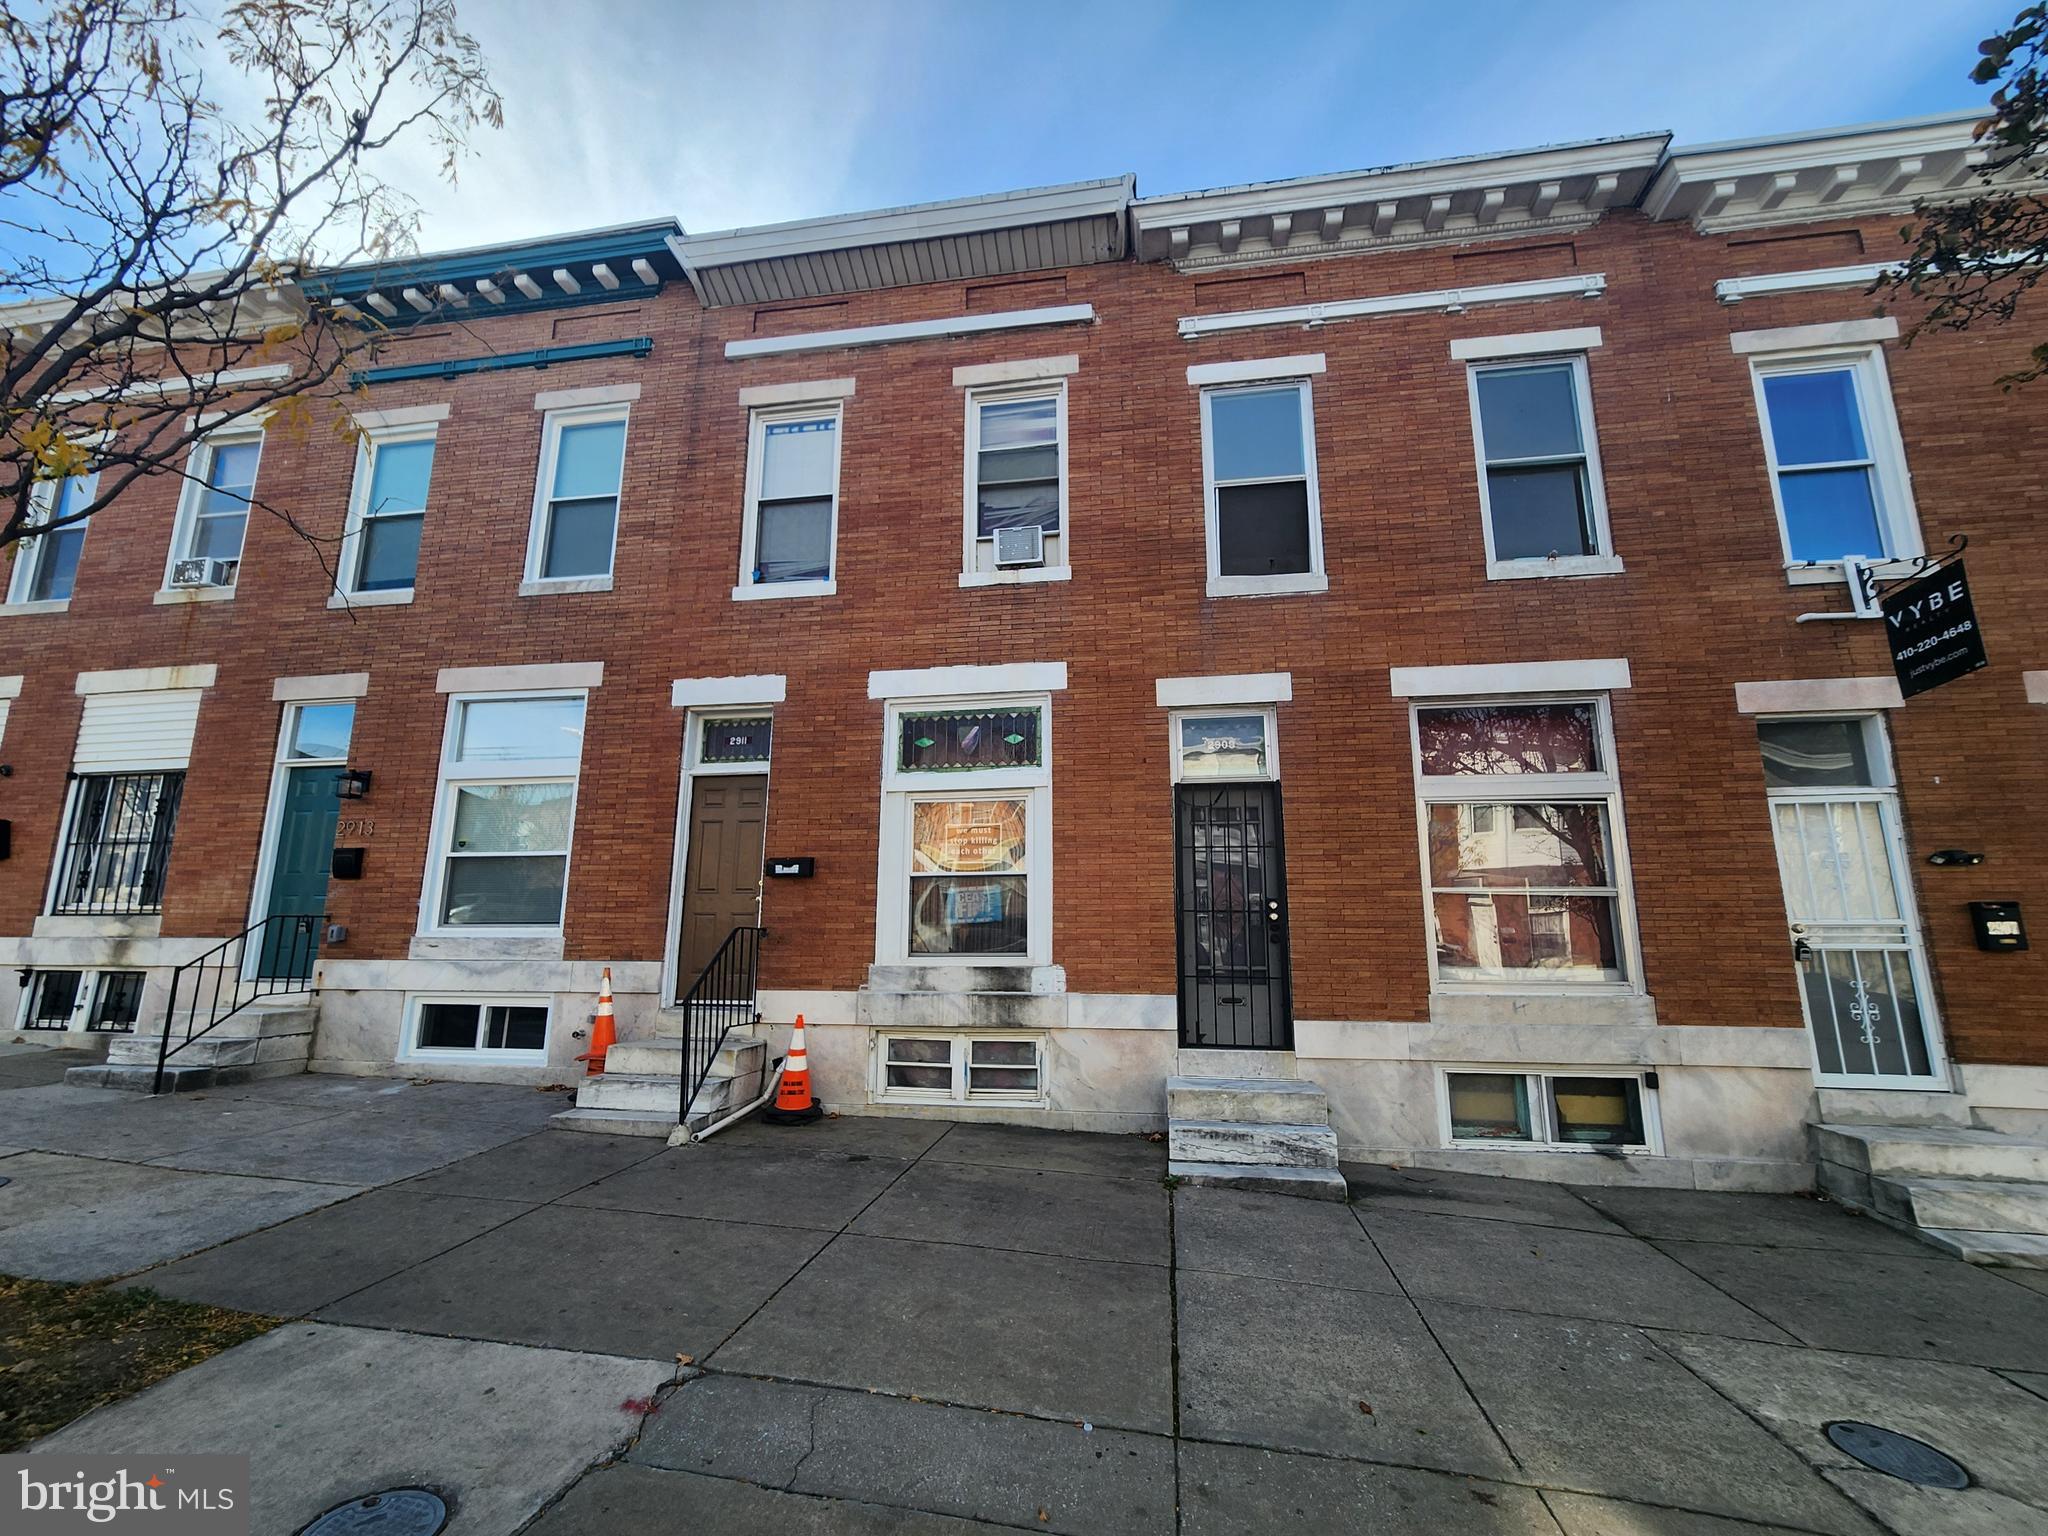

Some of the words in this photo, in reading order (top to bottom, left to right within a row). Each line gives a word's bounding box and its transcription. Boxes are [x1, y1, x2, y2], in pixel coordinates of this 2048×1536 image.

[1889, 580, 1964, 628] VYBE
[1896, 620, 1973, 661] 410-220-4648
[1910, 647, 1969, 679] justvybe.com
[729, 736, 747, 745] 2911
[336, 820, 375, 837] 2913
[970, 826, 992, 834] must
[950, 836, 968, 846] stop
[970, 836, 998, 845] killing
